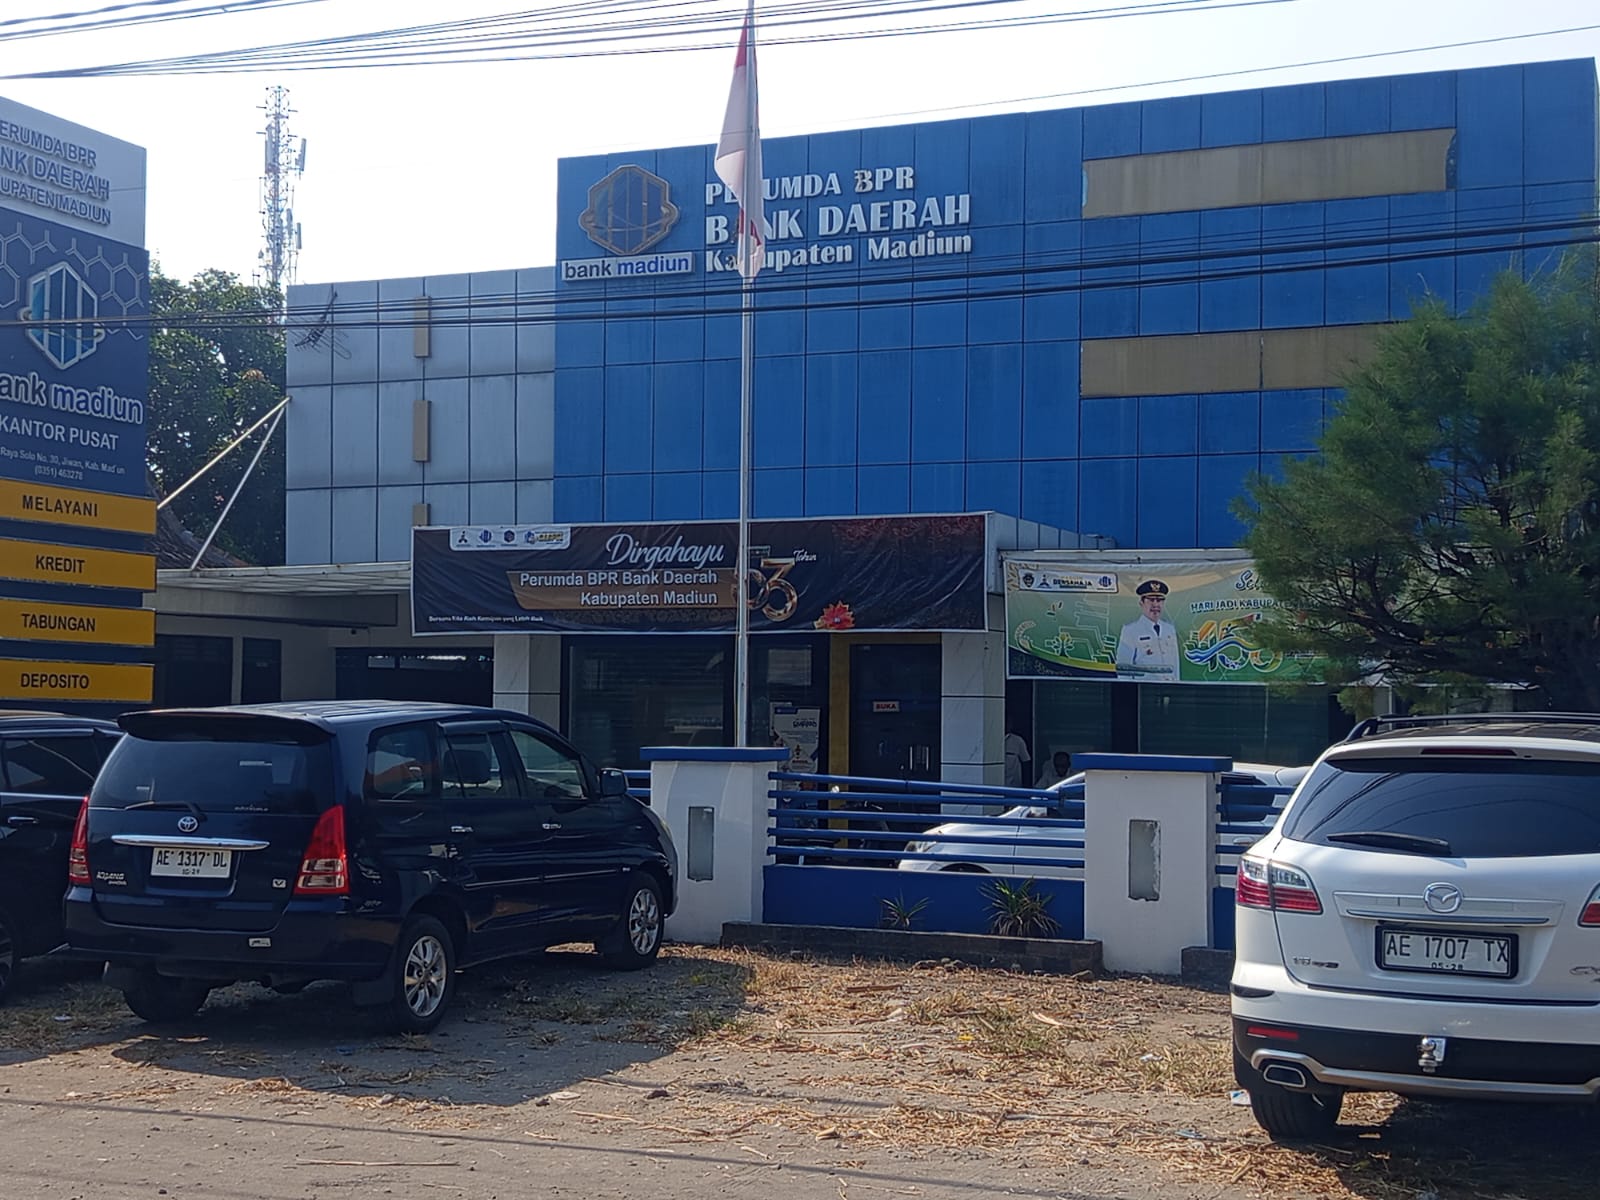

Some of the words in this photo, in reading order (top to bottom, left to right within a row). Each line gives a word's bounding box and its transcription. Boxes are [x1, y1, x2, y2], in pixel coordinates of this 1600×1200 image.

[0, 121, 65, 156] ERUMDA
[68, 144, 97, 167] BPR
[0, 146, 28, 175] NK
[34, 157, 110, 201] DAERAH
[854, 165, 915, 193] BPR
[0, 177, 56, 208] UPATEN
[58, 195, 111, 226] MADIUN
[705, 208, 803, 245] BNK
[818, 194, 970, 238] DAERAH
[705, 244, 852, 273] Kaupaten
[869, 231, 971, 261] Madiun
[565, 260, 611, 279] bank
[617, 256, 689, 275] madiun
[0, 371, 47, 407] ank
[51, 384, 143, 425] madiun
[0, 414, 65, 442] KANTOR
[69, 427, 118, 450] PUSAT
[20, 449, 35, 461] Solo
[34, 464, 57, 478] (0351)
[22, 495, 98, 517] MELAYANI
[605, 532, 724, 571] Dirgahayu
[36, 555, 85, 573] KREDIT
[519, 573, 583, 587] Perumda
[587, 572, 618, 585] BPR
[622, 571, 659, 585] Bank
[663, 569, 717, 585] Daerah
[580, 591, 659, 608] Kabupaten
[663, 591, 717, 605] Madiun
[1191, 602, 1214, 612] HARI
[1215, 600, 1237, 611] JADI
[22, 613, 96, 632] TABUNGAN
[21, 673, 89, 689] DEPOSITO
[156, 850, 170, 866] AE
[177, 850, 206, 867] 1317
[213, 851, 227, 868] DL
[1386, 935, 1411, 957] AE
[1425, 937, 1469, 960] 1707
[1484, 940, 1508, 963] TX
